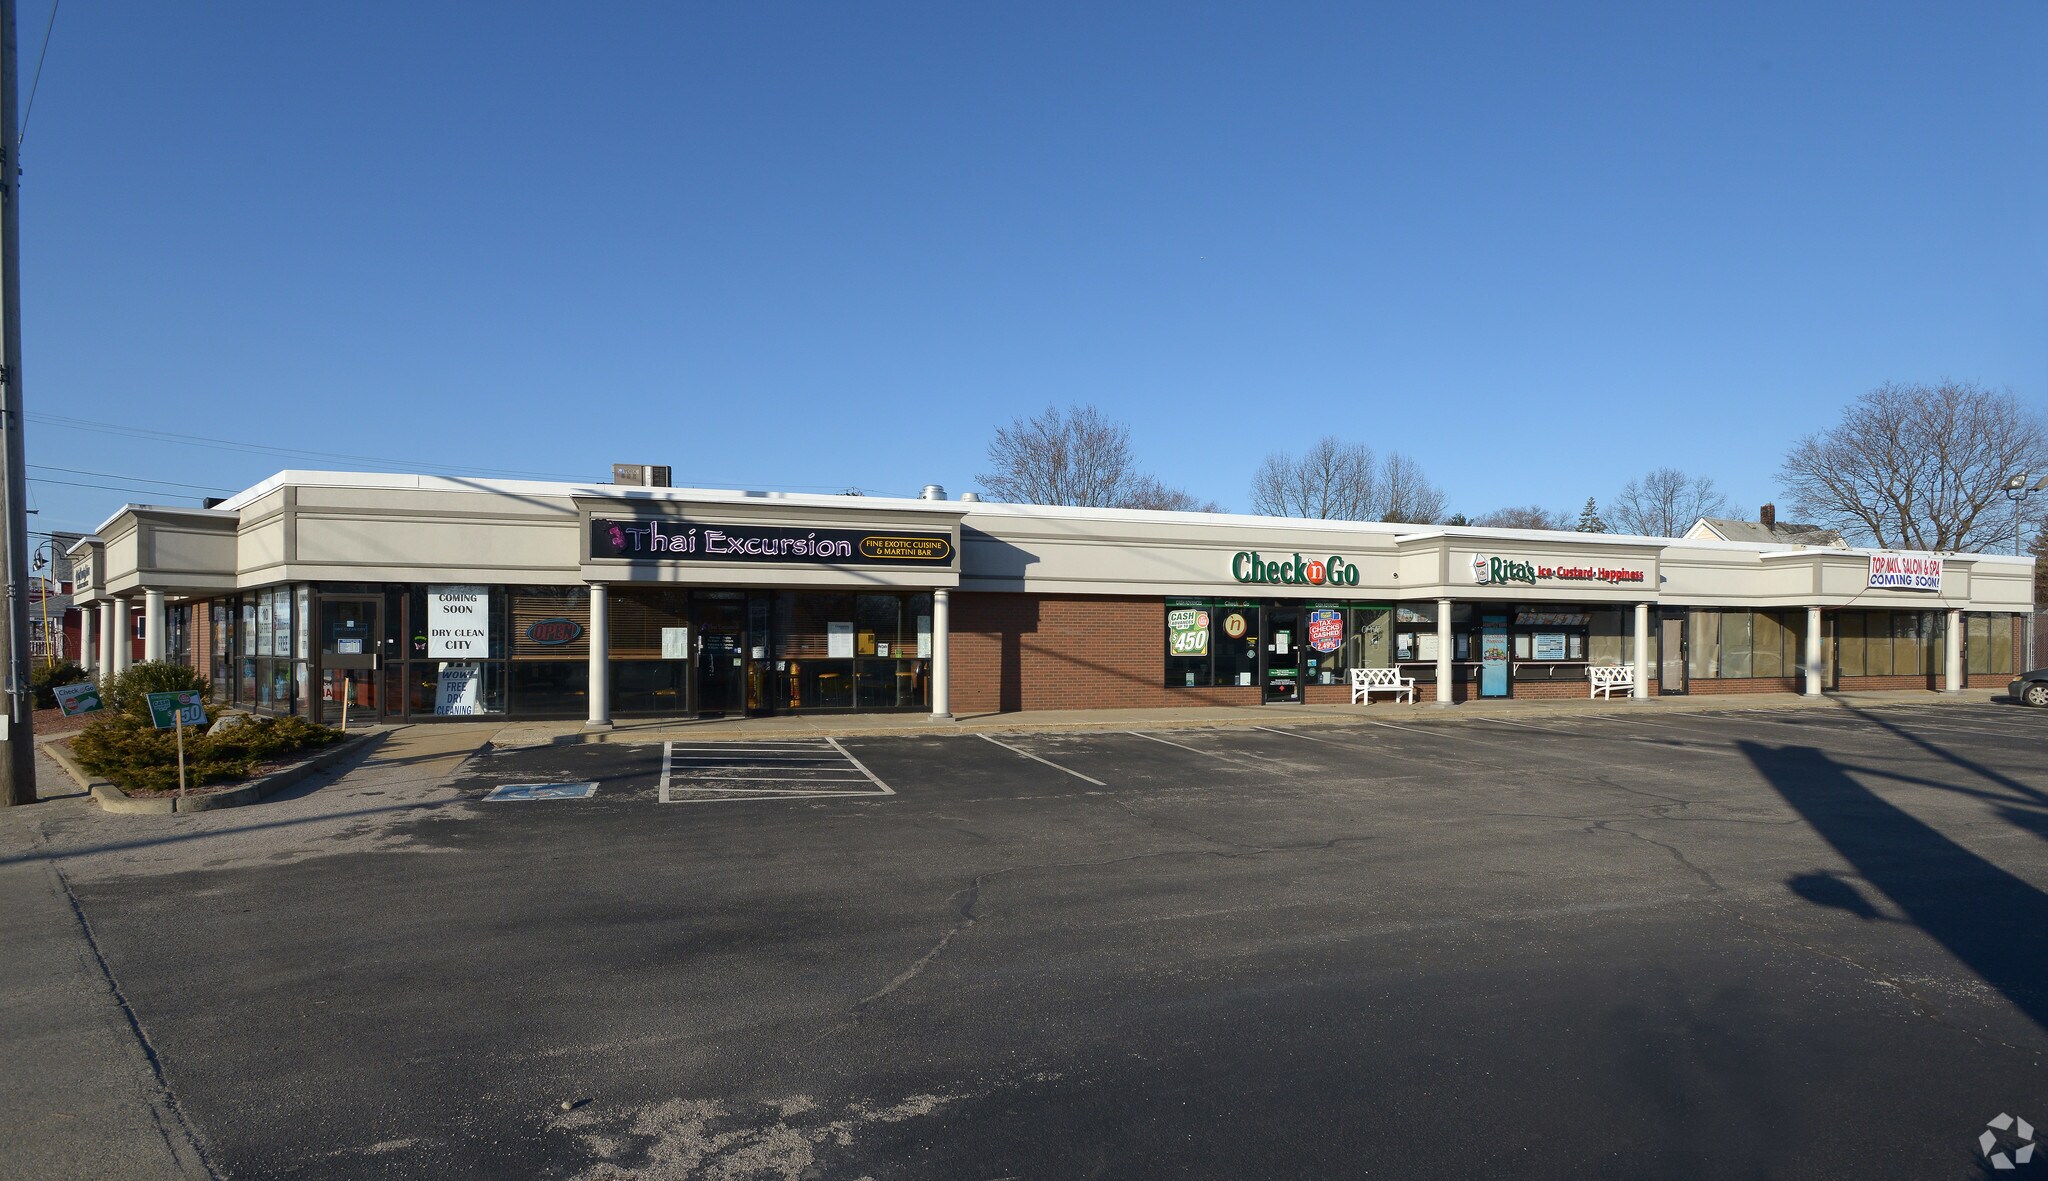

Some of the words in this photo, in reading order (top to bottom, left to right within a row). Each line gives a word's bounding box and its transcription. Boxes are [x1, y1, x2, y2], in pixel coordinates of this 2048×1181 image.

[626, 520, 697, 553] Thai
[704, 529, 852, 557] Excursion
[866, 540, 884, 548] FINE
[884, 540, 912, 549] EXOTIC
[912, 541, 942, 550] CUISINE
[876, 548, 883, 556] &
[883, 548, 917, 556] MARTINI
[1232, 551, 1308, 584] Check
[1326, 555, 1360, 586] Go
[1490, 556, 1536, 583] Rita's
[1538, 565, 1552, 577] Ice
[1556, 566, 1593, 579] Custard
[1598, 567, 1644, 582] Happiness
[1872, 556, 1886, 573] TOP
[1885, 557, 1901, 574] NAIL
[1902, 558, 1923, 575] SALON
[1924, 559, 1929, 575] &
[1929, 560, 1940, 577] SPA
[1870, 574, 1912, 586] COMING
[1915, 575, 1940, 588] SOON!
[438, 593, 477, 602] COMING
[443, 605, 473, 614] SOON
[1170, 612, 1194, 621] CASH
[431, 629, 452, 637] DRY
[454, 629, 485, 637] CLEAN
[532, 622, 575, 641] OPEN
[1311, 624, 1340, 633] CHECKS
[1313, 630, 1339, 639] CASHED
[445, 640, 472, 650] CITY
[1172, 630, 1206, 651] $450
[1317, 642, 1336, 650] 2.49%
[442, 670, 475, 679] WOW!
[446, 681, 467, 692] FREE
[59, 688, 79, 696] Check
[447, 693, 464, 704] DRY
[436, 705, 472, 715] CLEANING
